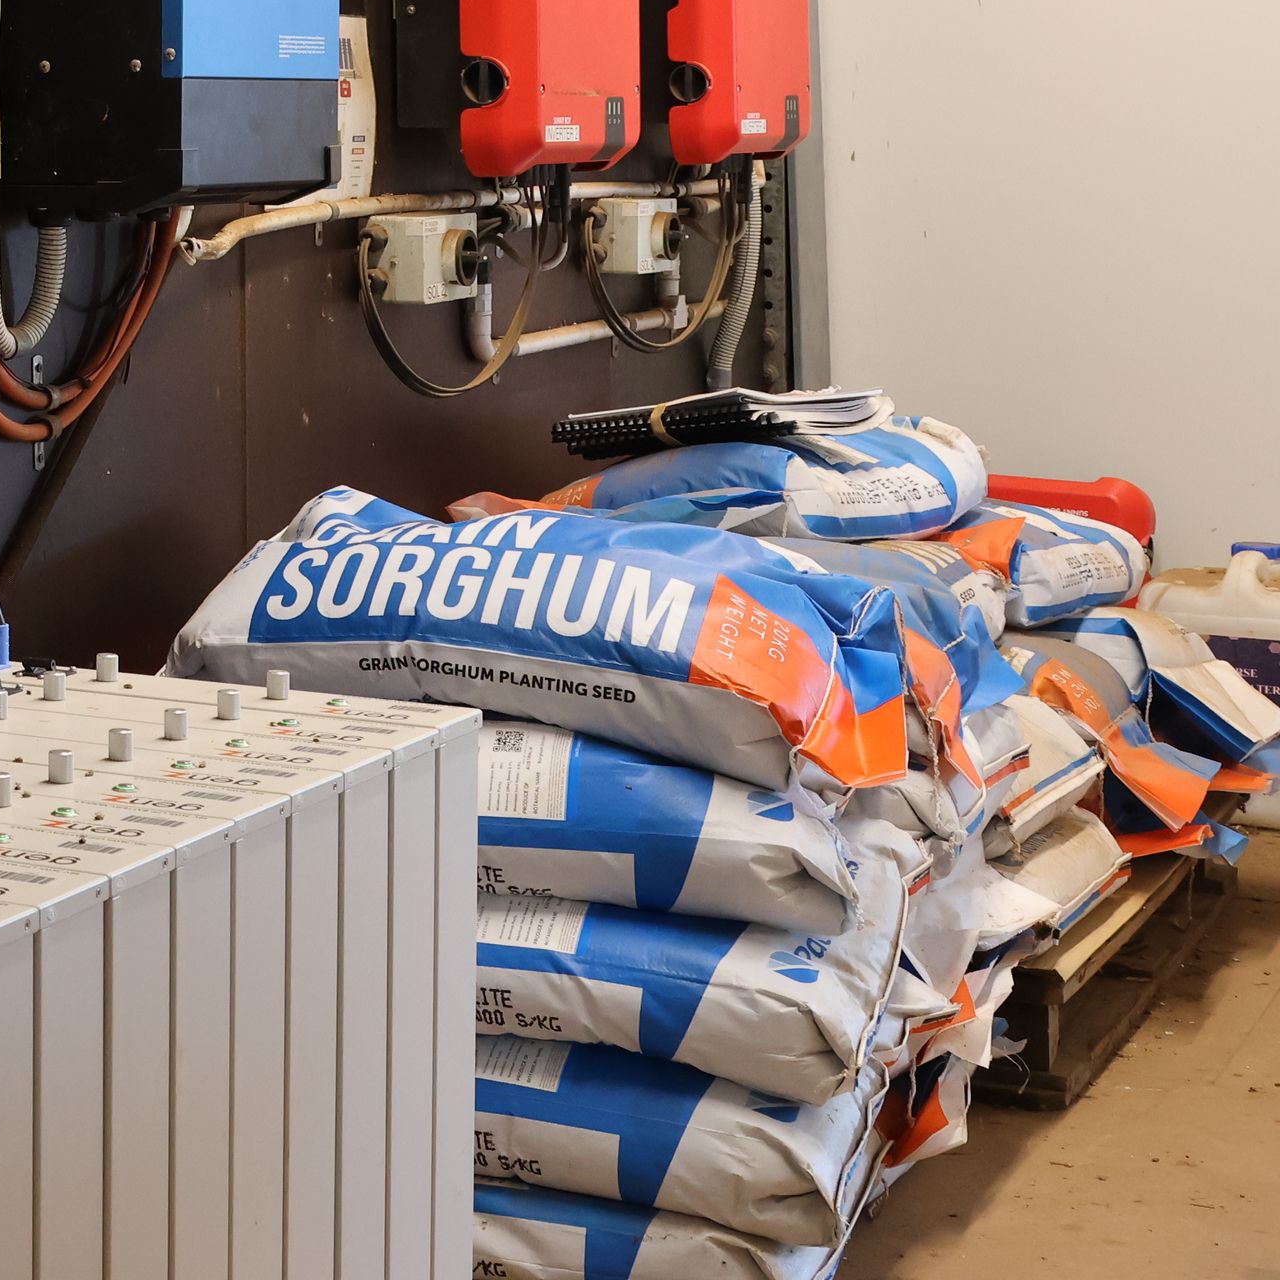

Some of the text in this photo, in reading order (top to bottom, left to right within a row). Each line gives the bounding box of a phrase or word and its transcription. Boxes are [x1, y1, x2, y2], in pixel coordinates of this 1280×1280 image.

[265, 542, 697, 653] SORGHUM
[959, 588, 976, 603] SEED
[715, 593, 747, 660] WEIGHT
[748, 607, 768, 640] NET
[768, 620, 790, 662] 20KG
[359, 656, 409, 671] GRAIN
[499, 670, 588, 697] PLANTING
[591, 684, 637, 704] SEED
[476, 987, 513, 1008] ITE
